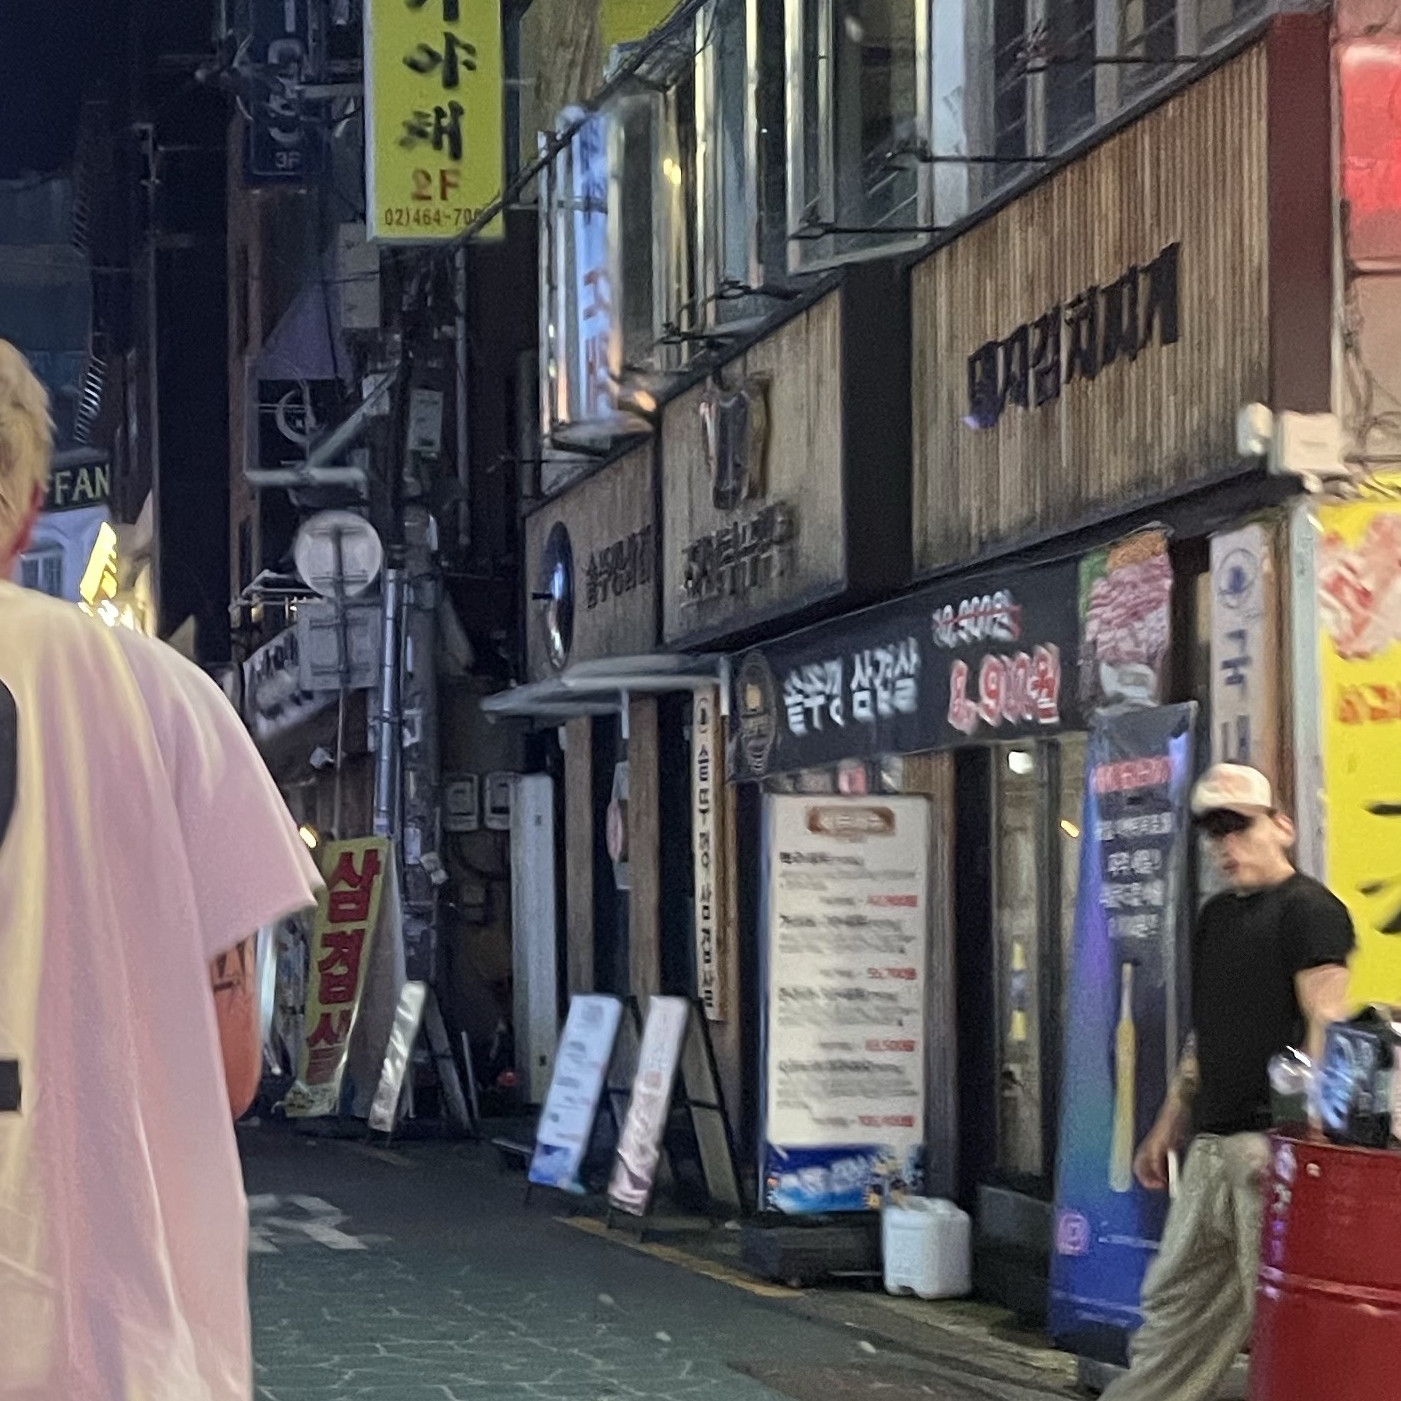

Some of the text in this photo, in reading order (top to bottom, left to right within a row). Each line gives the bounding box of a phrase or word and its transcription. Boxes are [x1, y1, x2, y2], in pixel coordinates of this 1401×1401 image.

[410, 168, 461, 201] 2F
[48, 464, 110, 504] FAN
[850, 637, 921, 724] 삼겹살
[305, 848, 381, 1086] 삼겹살
